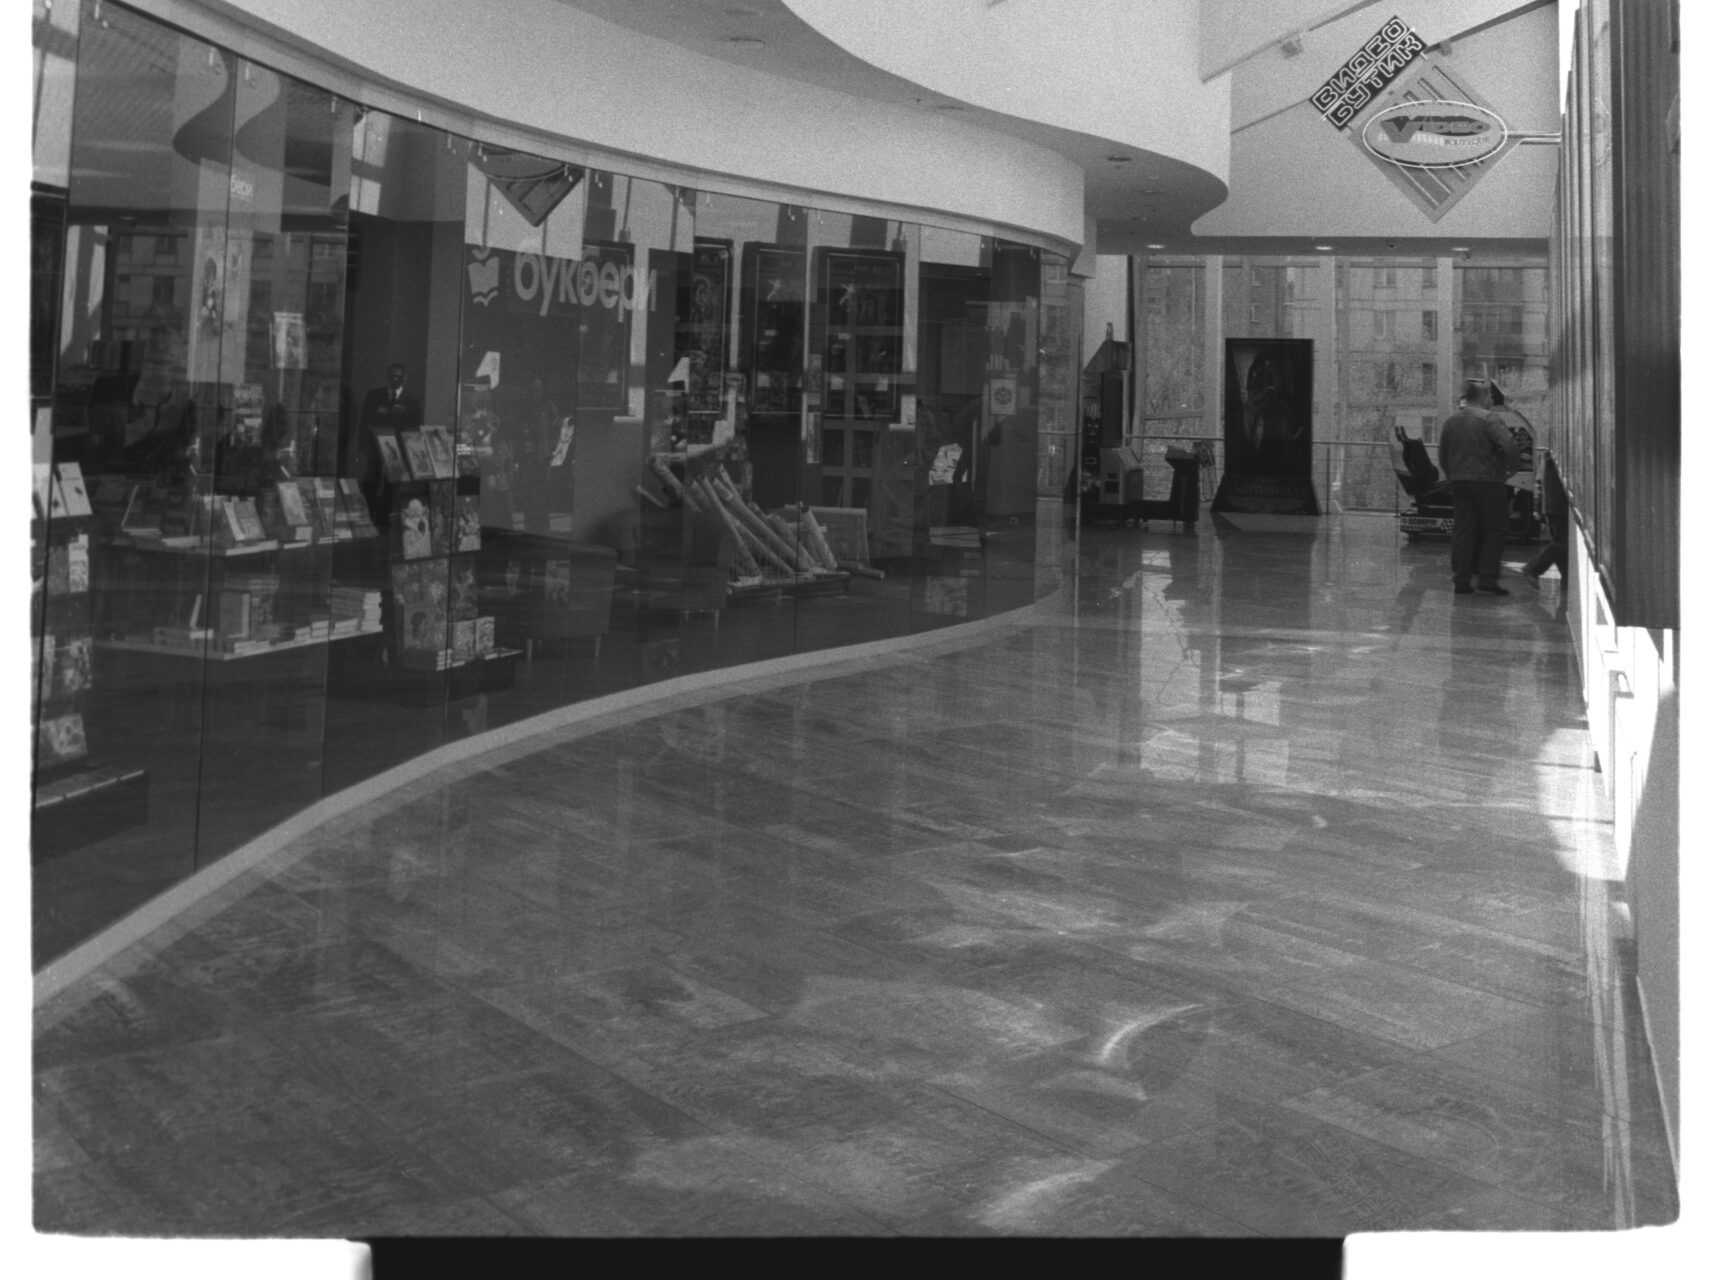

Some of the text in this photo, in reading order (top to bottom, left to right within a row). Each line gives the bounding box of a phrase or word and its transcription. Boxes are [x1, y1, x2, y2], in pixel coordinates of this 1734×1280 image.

[1312, 18, 1408, 113] ВИДЕО
[1327, 35, 1423, 127] БУТИК
[1380, 116, 1492, 144] VIDEO
